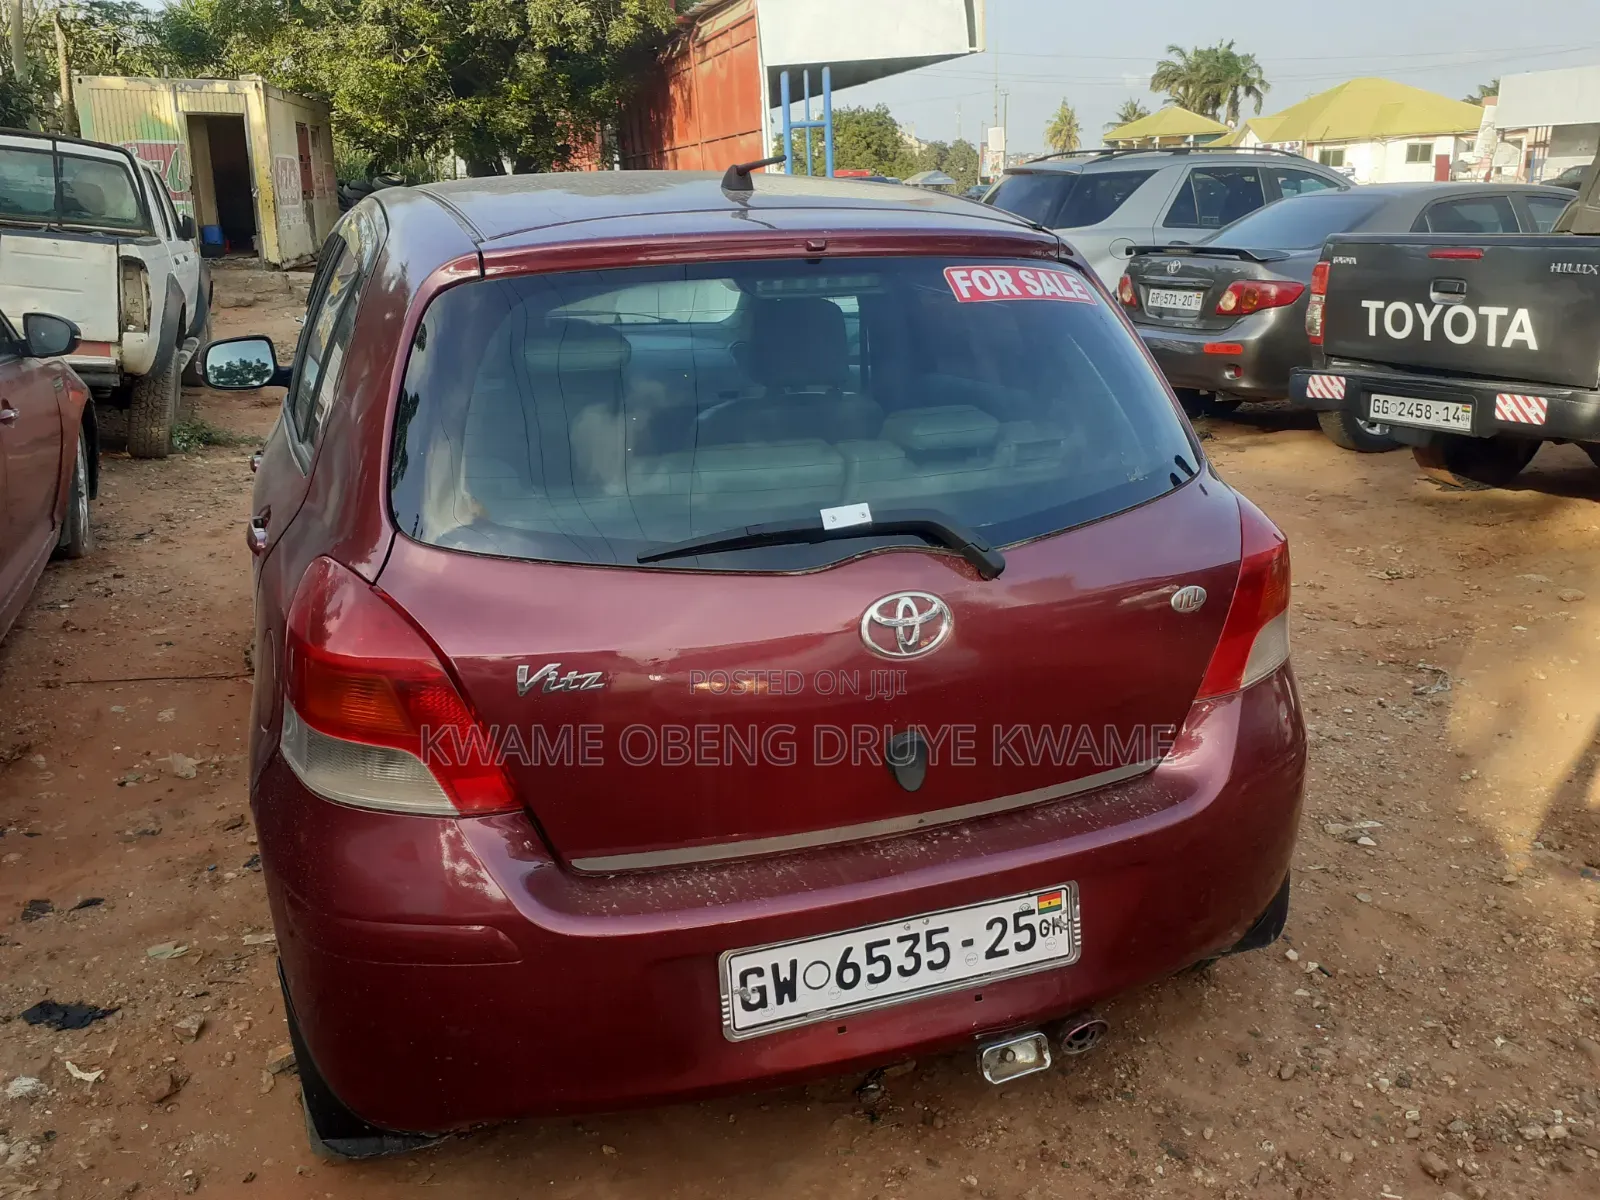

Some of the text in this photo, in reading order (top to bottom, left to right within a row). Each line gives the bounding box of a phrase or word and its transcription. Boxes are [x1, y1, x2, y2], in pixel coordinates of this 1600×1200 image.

[950, 269, 1091, 300] FOR SALE
[1549, 262, 1599, 275] HILUX
[1361, 300, 1539, 350] TOYOTA
[1372, 398, 1389, 414] GG
[1461, 413, 1470, 423] GH
[517, 662, 605, 696] Vitz
[738, 958, 798, 1012] GW
